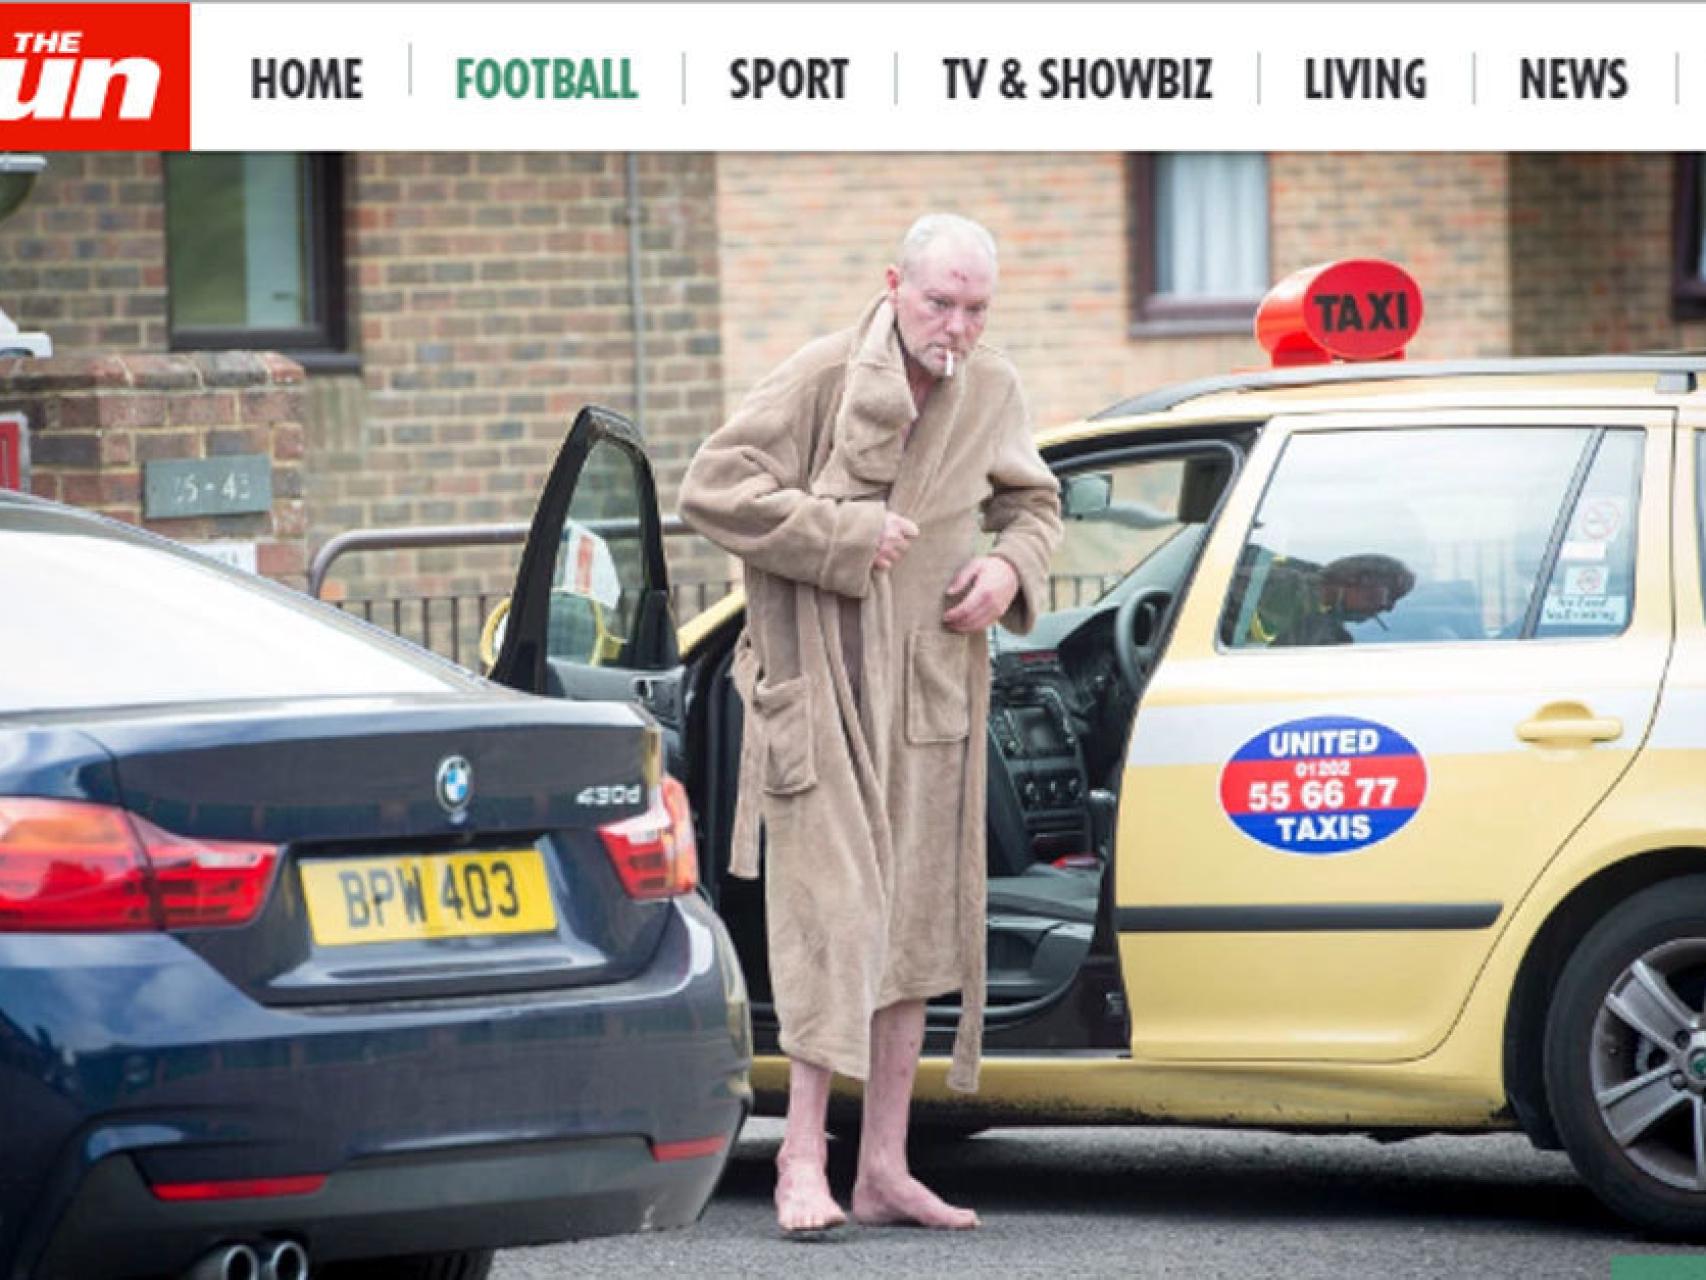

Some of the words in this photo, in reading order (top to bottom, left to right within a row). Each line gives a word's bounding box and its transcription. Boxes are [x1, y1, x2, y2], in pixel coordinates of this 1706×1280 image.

[1313, 291, 1409, 333] TAXI
[1269, 729, 1380, 757] UNITED
[1248, 781, 1291, 811] 55
[1302, 780, 1345, 809] 66
[1355, 777, 1399, 806] 77
[1276, 815, 1372, 842] TAXIS
[339, 866, 427, 928] BPW
[442, 861, 519, 920] 403
